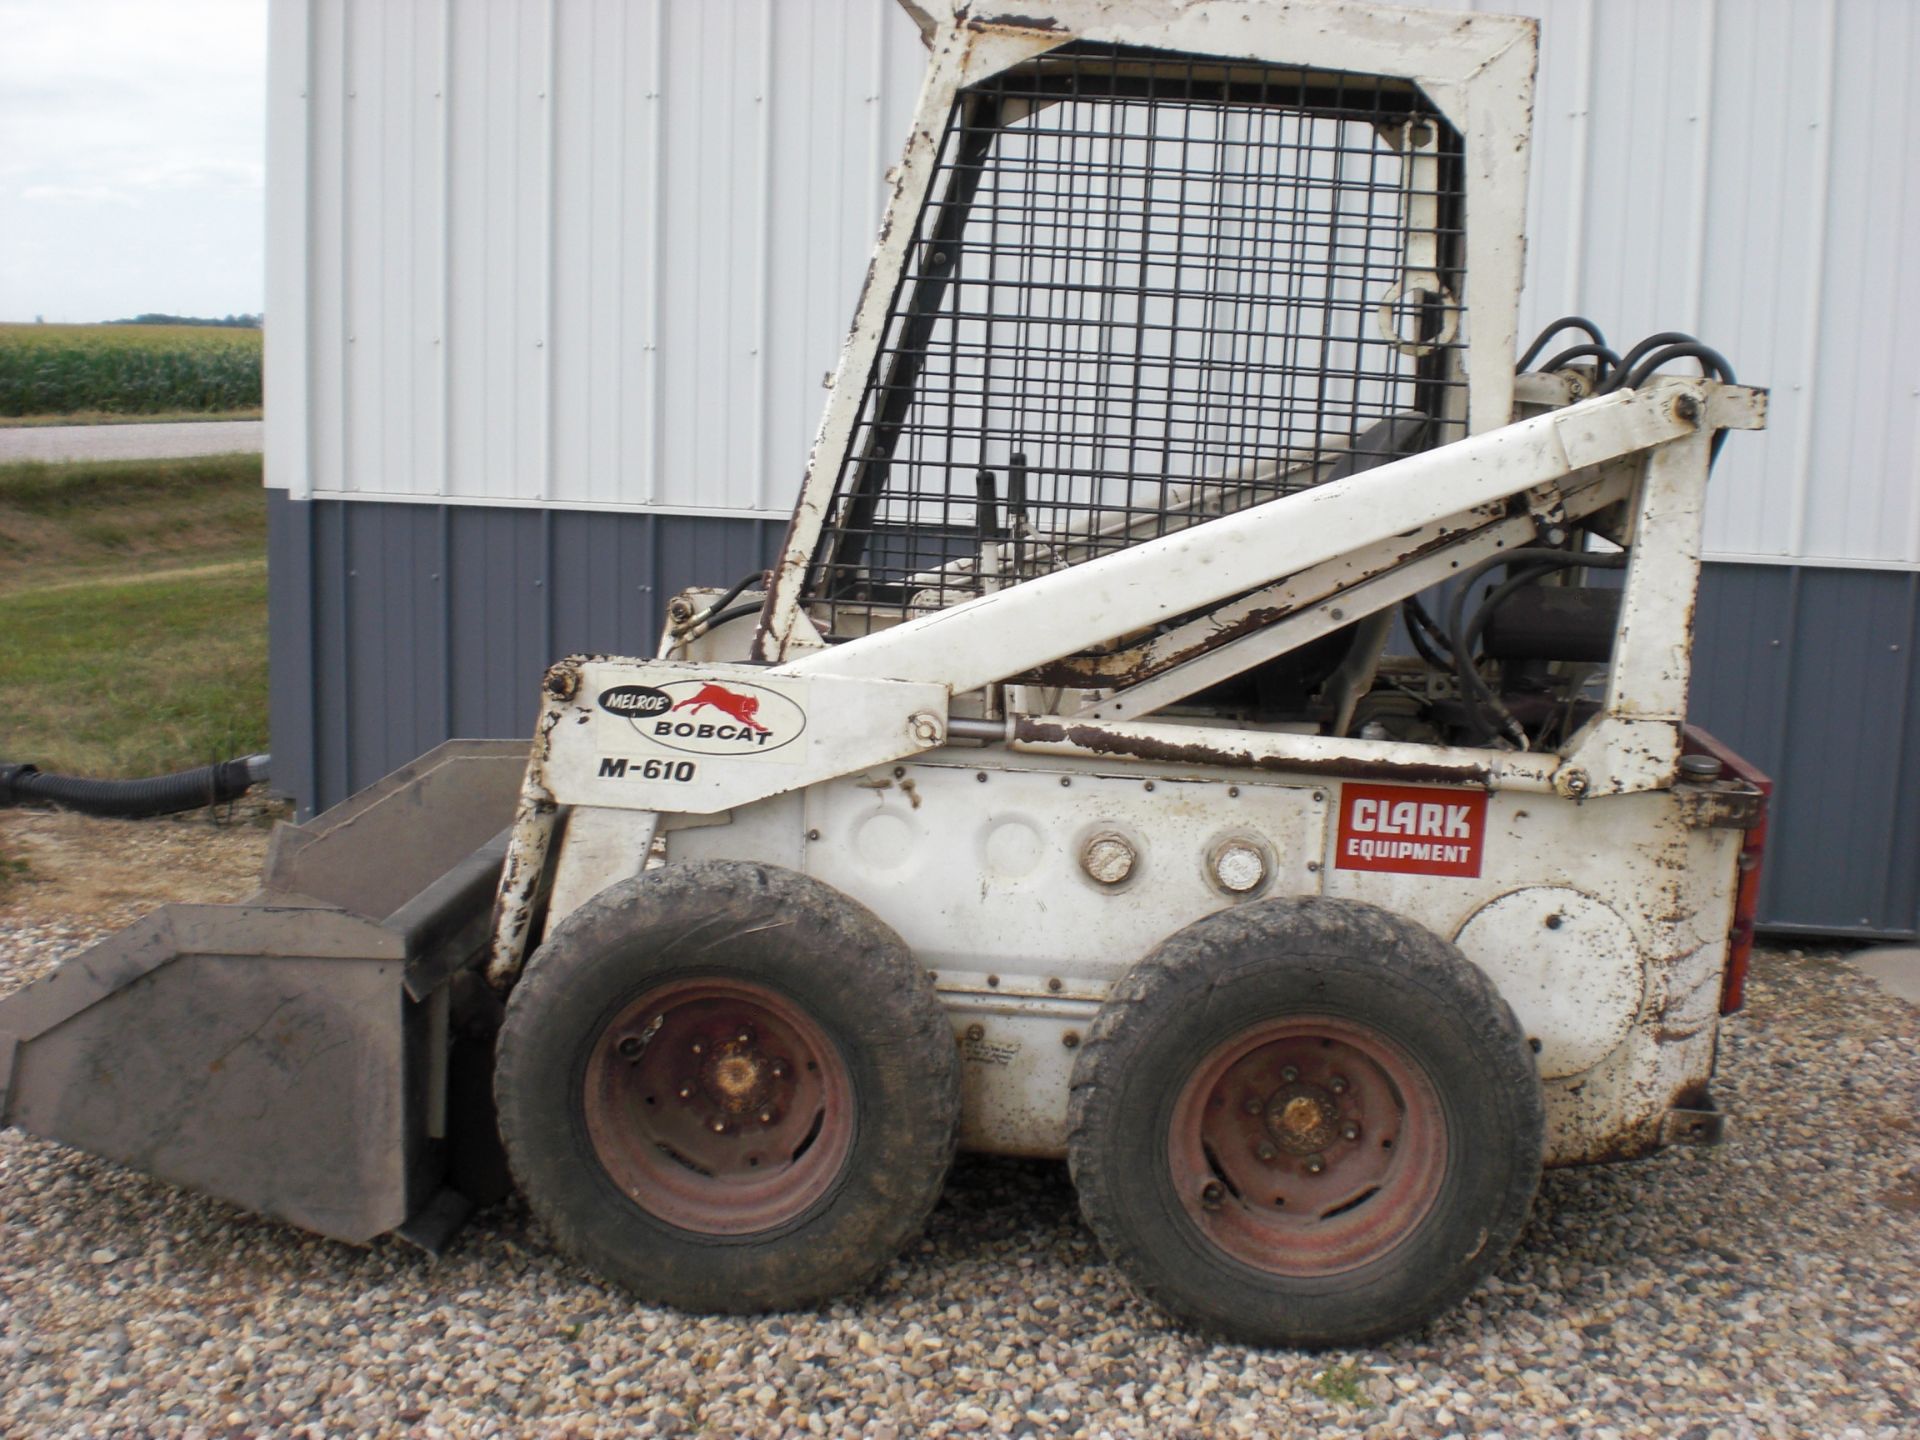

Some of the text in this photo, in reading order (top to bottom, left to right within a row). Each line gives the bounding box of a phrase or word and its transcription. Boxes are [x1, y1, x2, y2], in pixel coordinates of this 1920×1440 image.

[606, 693, 665, 711] MELROE
[654, 721, 774, 745] BOBCAT
[598, 757, 696, 782] M-610
[1352, 798, 1472, 839] CLARK
[1347, 838, 1471, 864] EQUIPMENT
